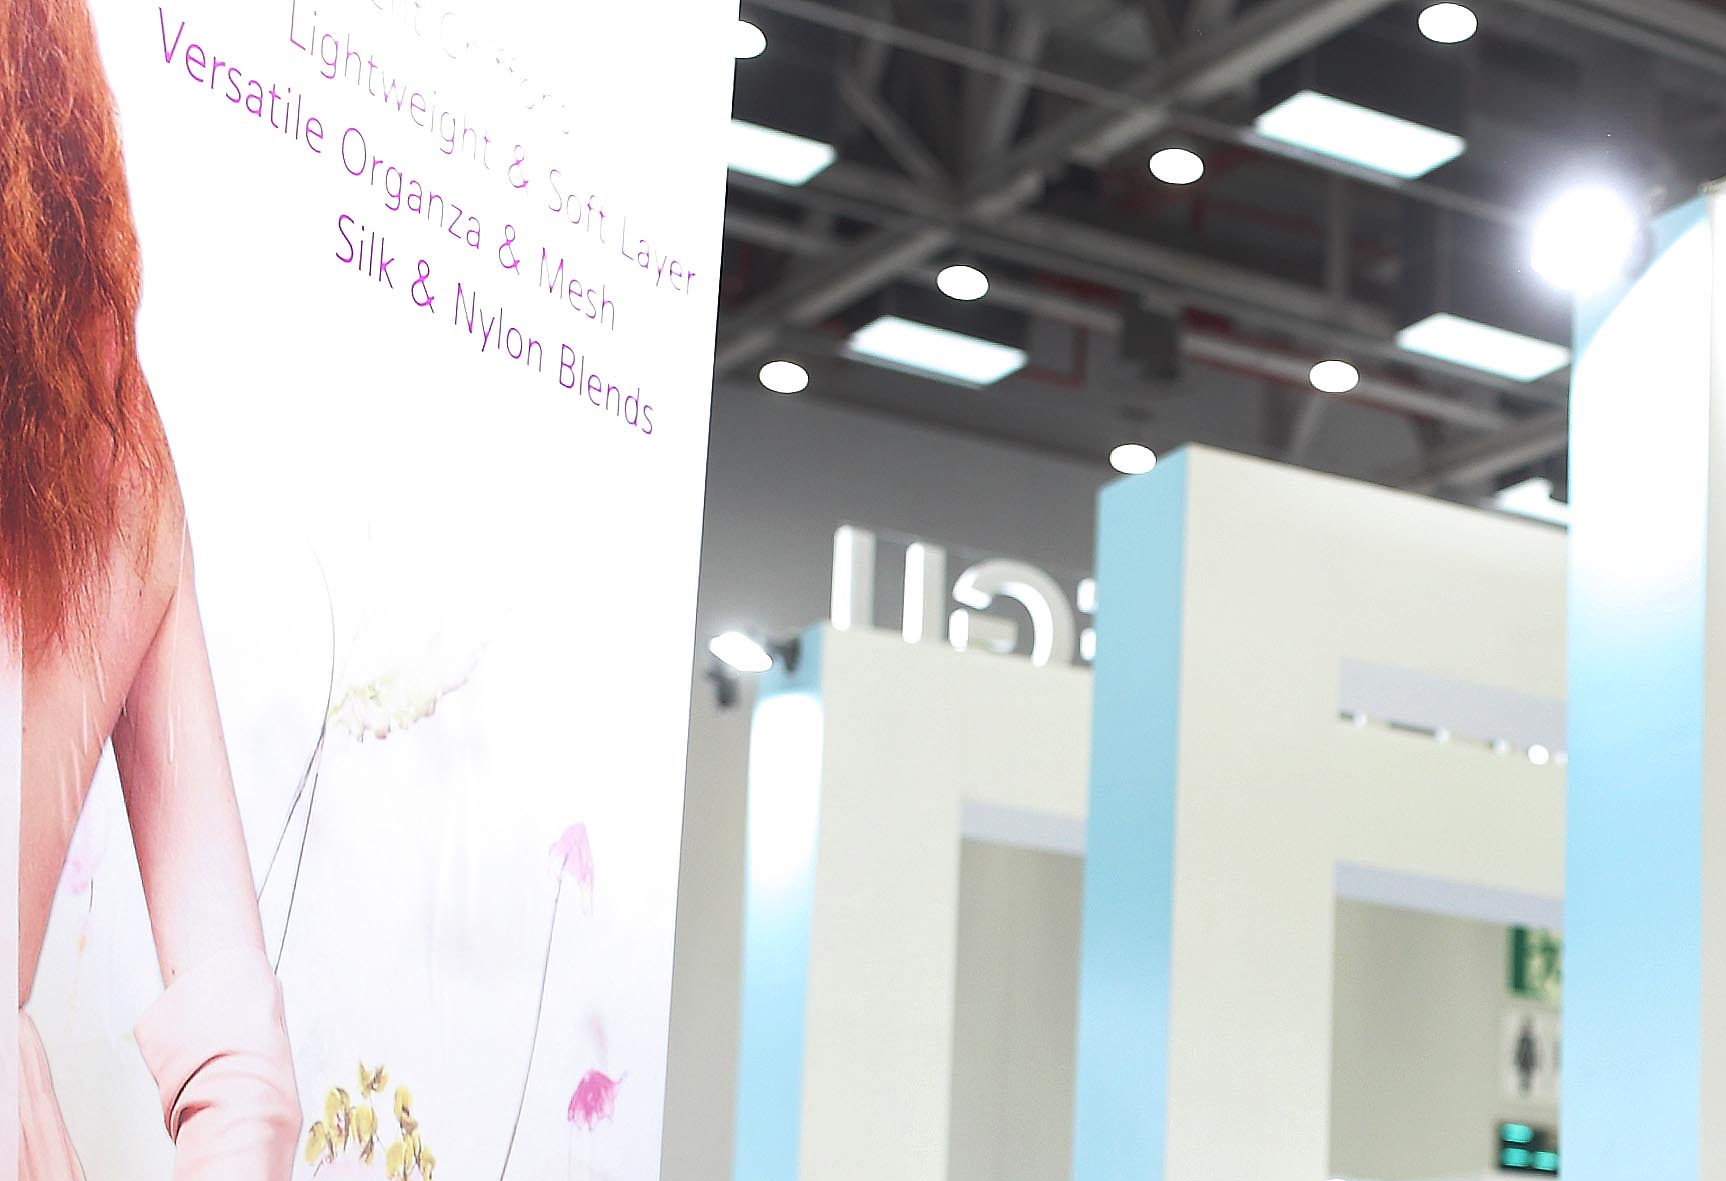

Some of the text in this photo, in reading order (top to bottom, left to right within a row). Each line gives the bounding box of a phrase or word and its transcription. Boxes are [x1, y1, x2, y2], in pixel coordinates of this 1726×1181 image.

[158, 6, 325, 155] Versatile
[341, 127, 483, 251] Organza
[498, 224, 521, 276] &
[538, 246, 617, 332] Mesh
[288, 0, 492, 171] Lightweight
[507, 144, 530, 189] &
[548, 169, 607, 244] Soft
[620, 215, 697, 295] Layer
[335, 213, 655, 436] Silk & Nylon Blends
